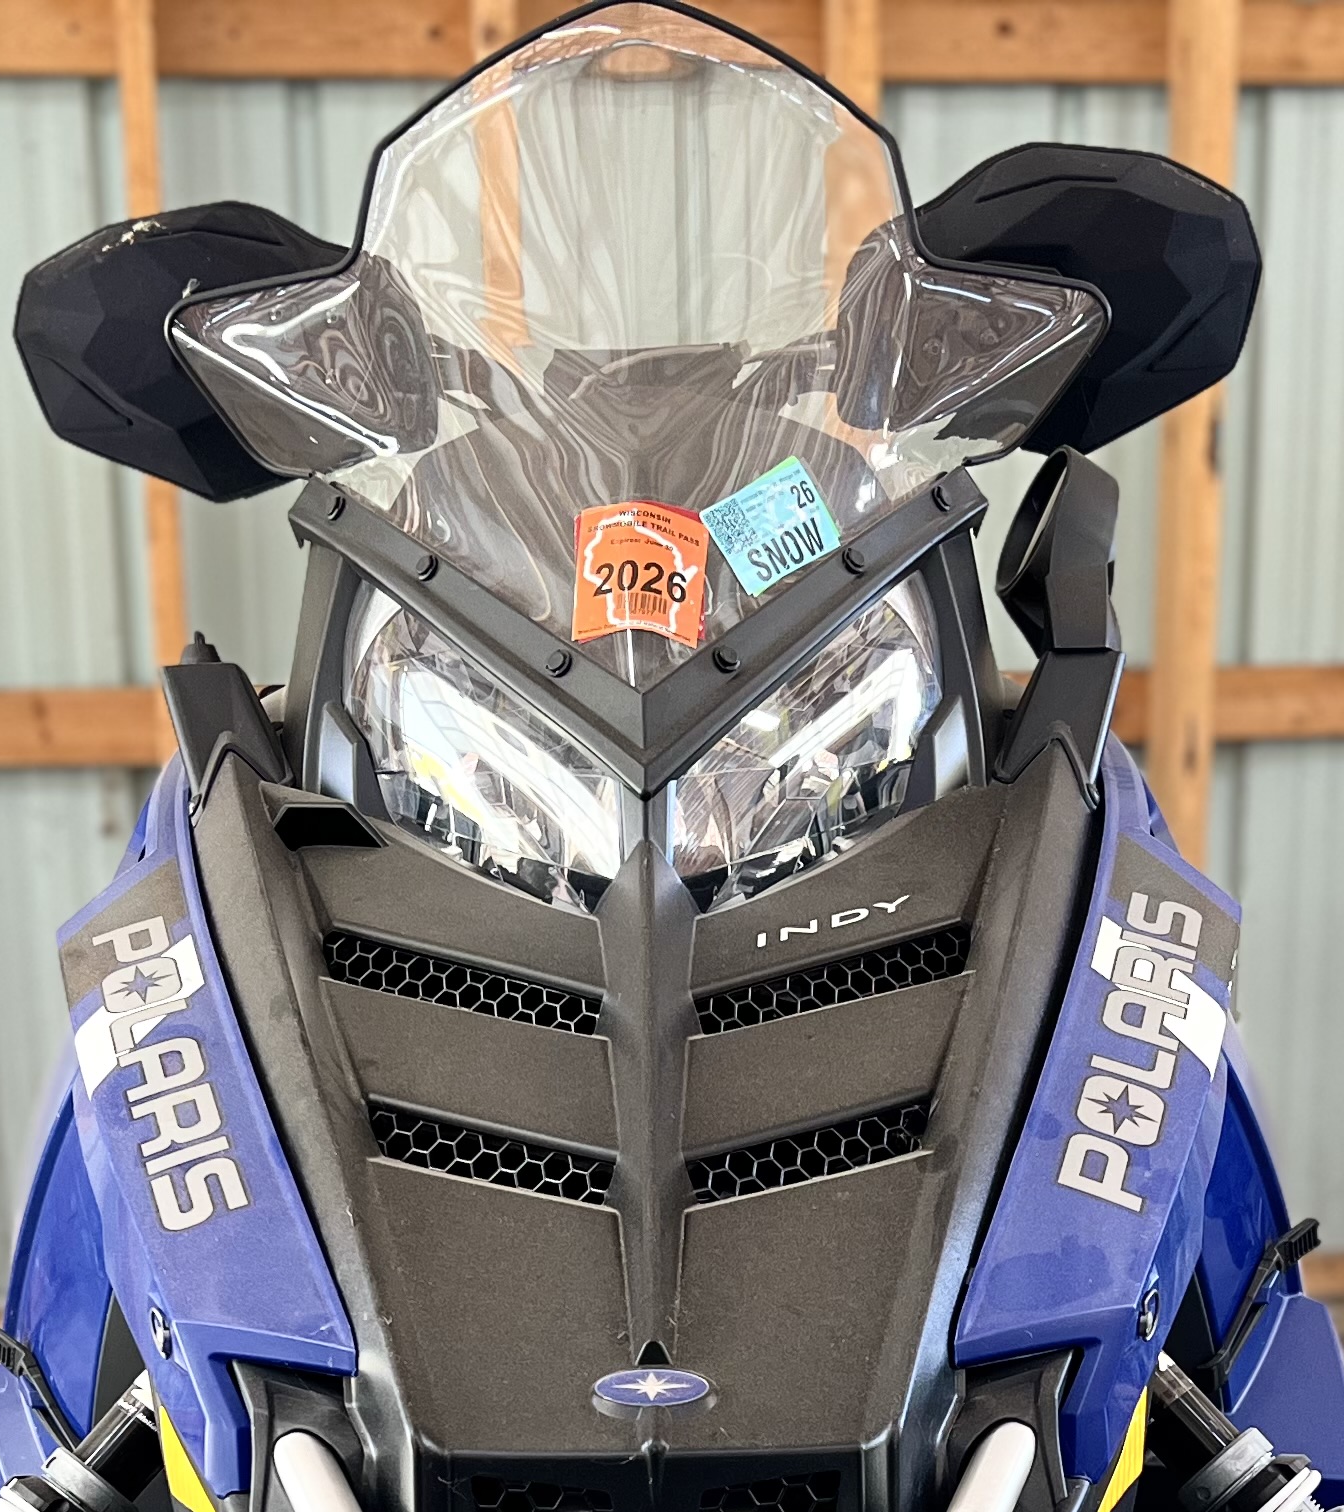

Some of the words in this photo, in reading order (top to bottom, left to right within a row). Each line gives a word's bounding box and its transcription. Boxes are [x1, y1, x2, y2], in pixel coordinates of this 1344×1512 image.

[619, 510, 671, 524] WISCONSIN
[790, 480, 815, 509] 26
[587, 520, 648, 533] SNOWMOBILE
[650, 522, 676, 537] TRAIL
[678, 532, 700, 547] PASS
[747, 517, 824, 582] SNOW
[593, 560, 687, 603] 2026
[757, 894, 910, 948] INDY
[92, 915, 249, 1232] POLARIS
[1058, 891, 1203, 1212] POLARIS
